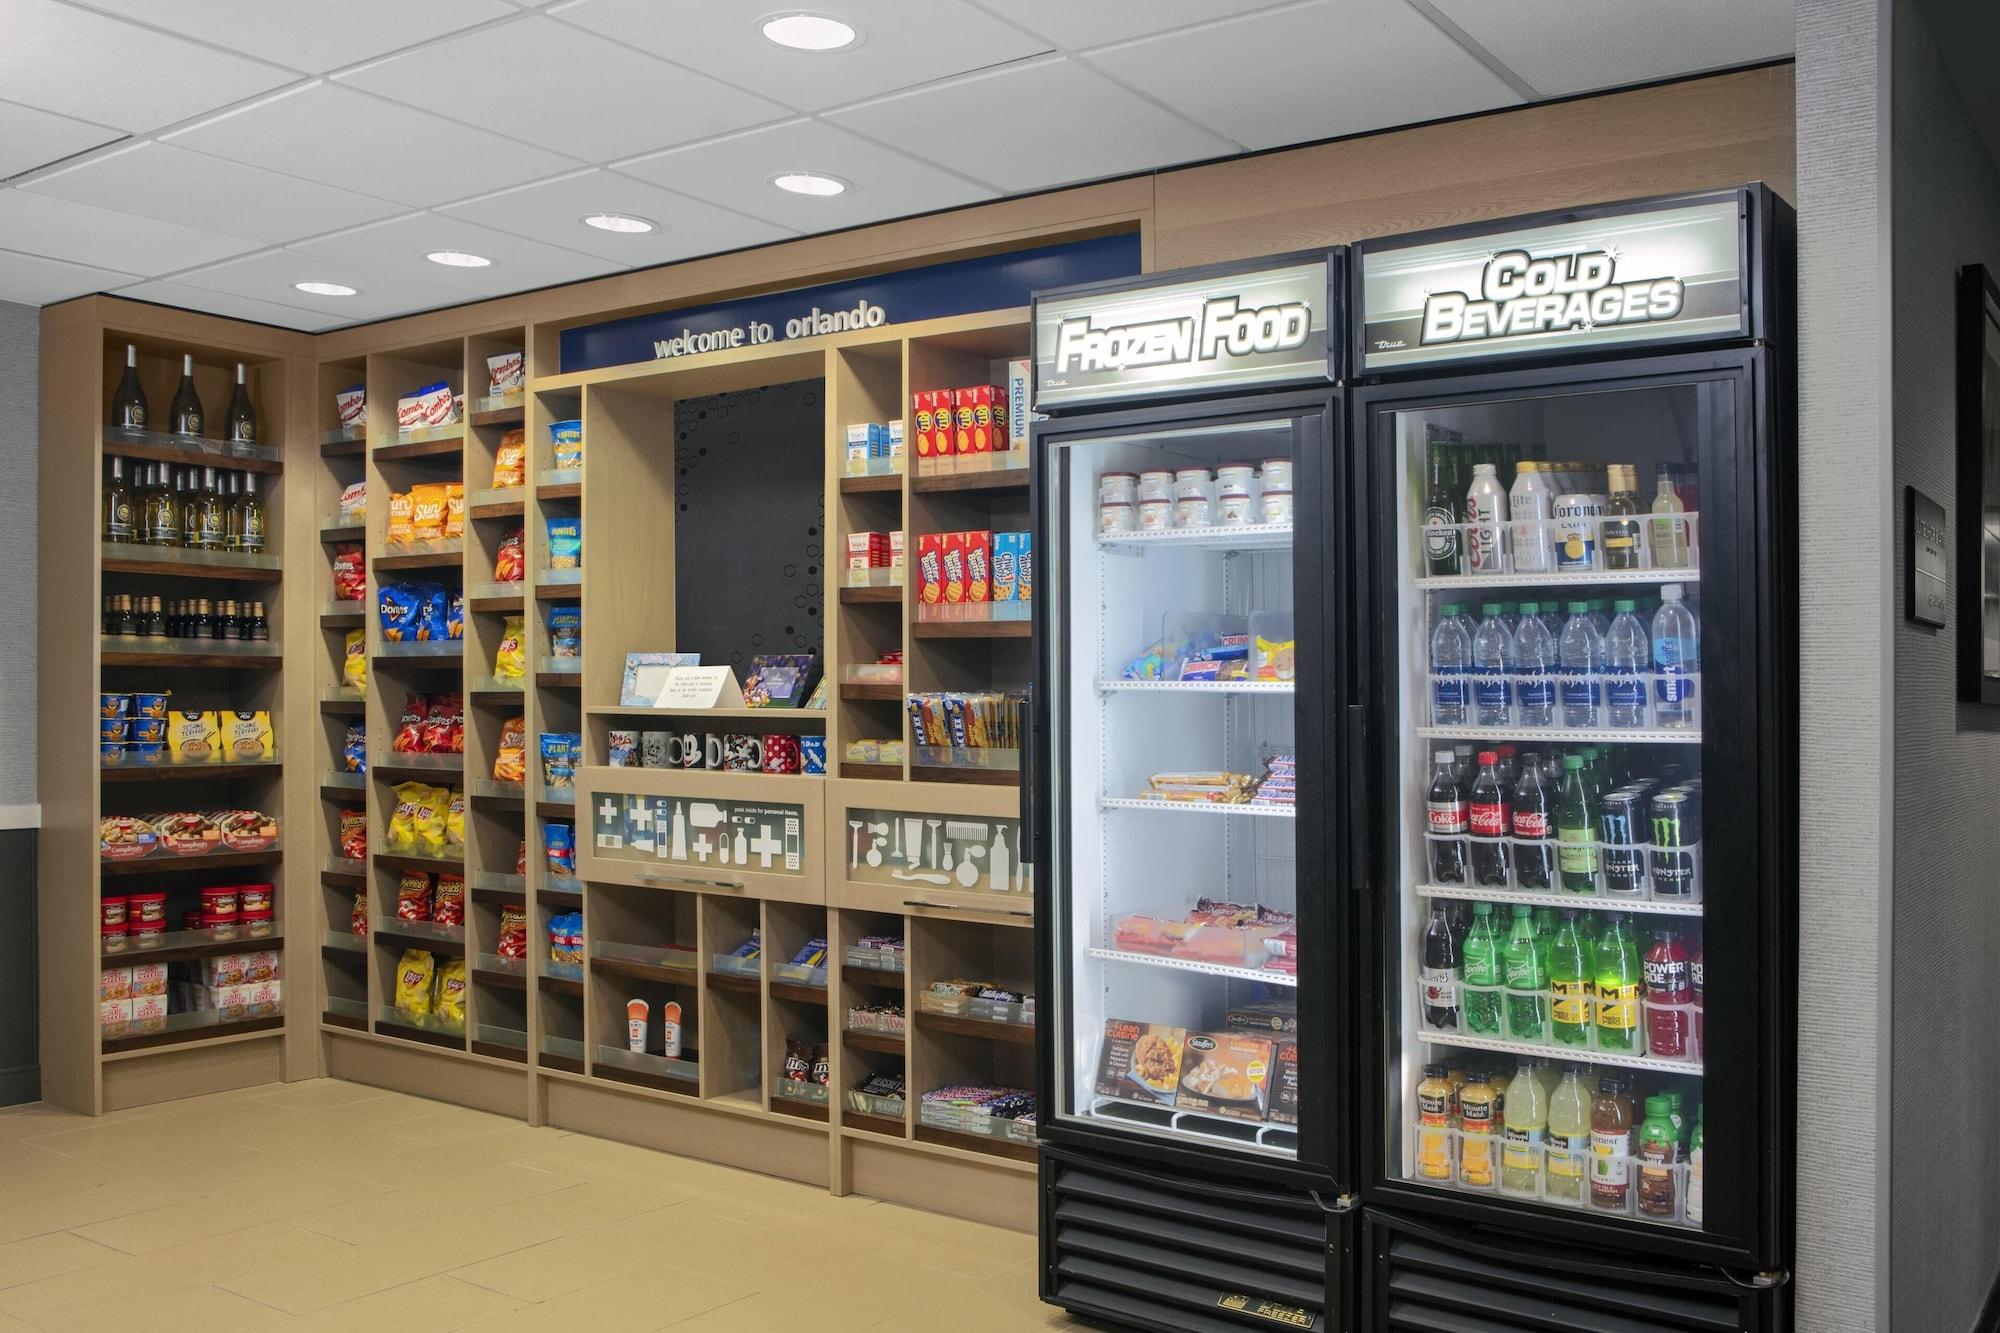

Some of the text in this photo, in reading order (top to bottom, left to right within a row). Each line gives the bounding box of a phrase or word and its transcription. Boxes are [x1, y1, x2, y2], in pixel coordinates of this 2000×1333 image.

[1482, 250, 1616, 300] COLD
[653, 299, 886, 359] welcome to orlando
[1056, 295, 1311, 373] FROZEN FOOD
[1420, 276, 1684, 346] BEVERAGES
[1014, 377, 1025, 438] PREMIUM
[1644, 960, 1685, 974] POWER
[1257, 1305, 1307, 1325] FREEZER
